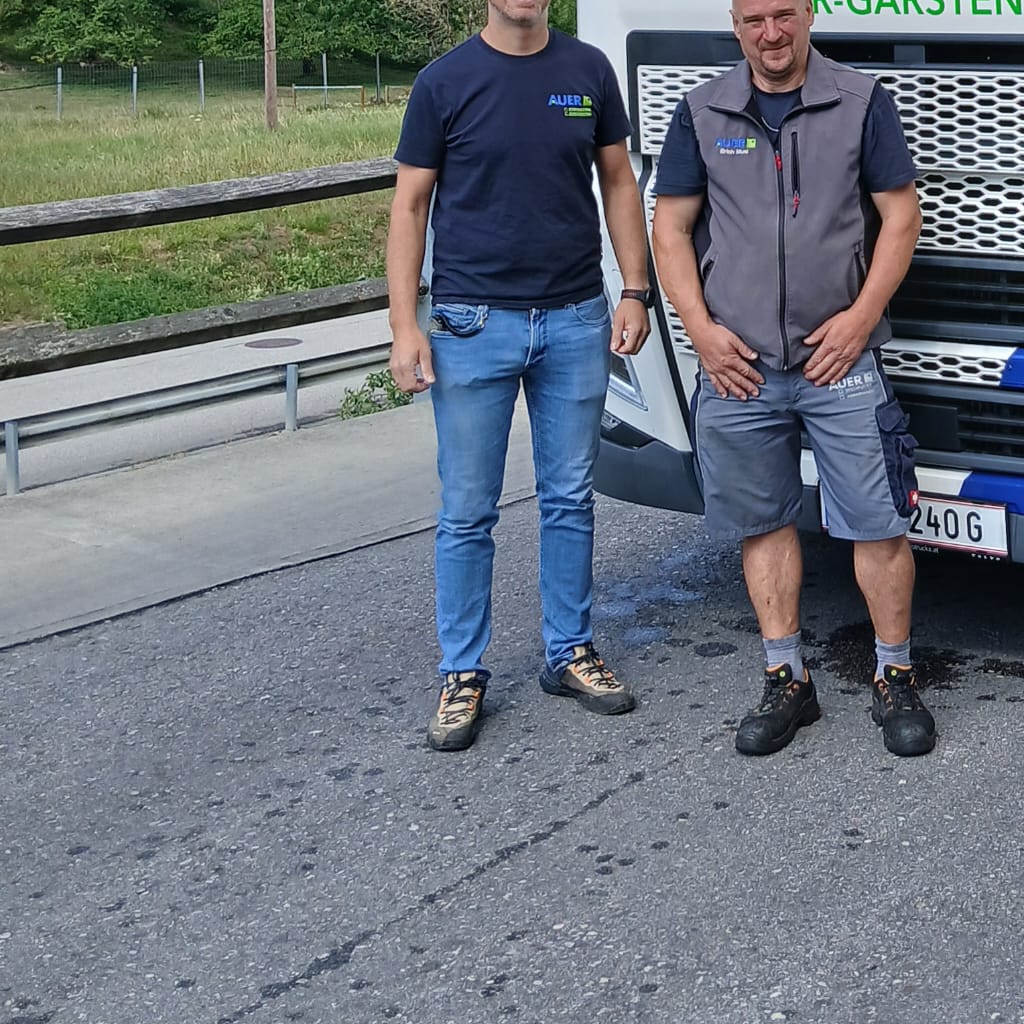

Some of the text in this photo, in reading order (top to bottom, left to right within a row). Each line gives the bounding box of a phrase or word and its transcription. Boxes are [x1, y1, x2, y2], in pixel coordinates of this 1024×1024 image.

[547, 94, 582, 107] AUER
[714, 138, 745, 149] AUER
[829, 375, 863, 391] AUER
[967, 511, 984, 543] G
